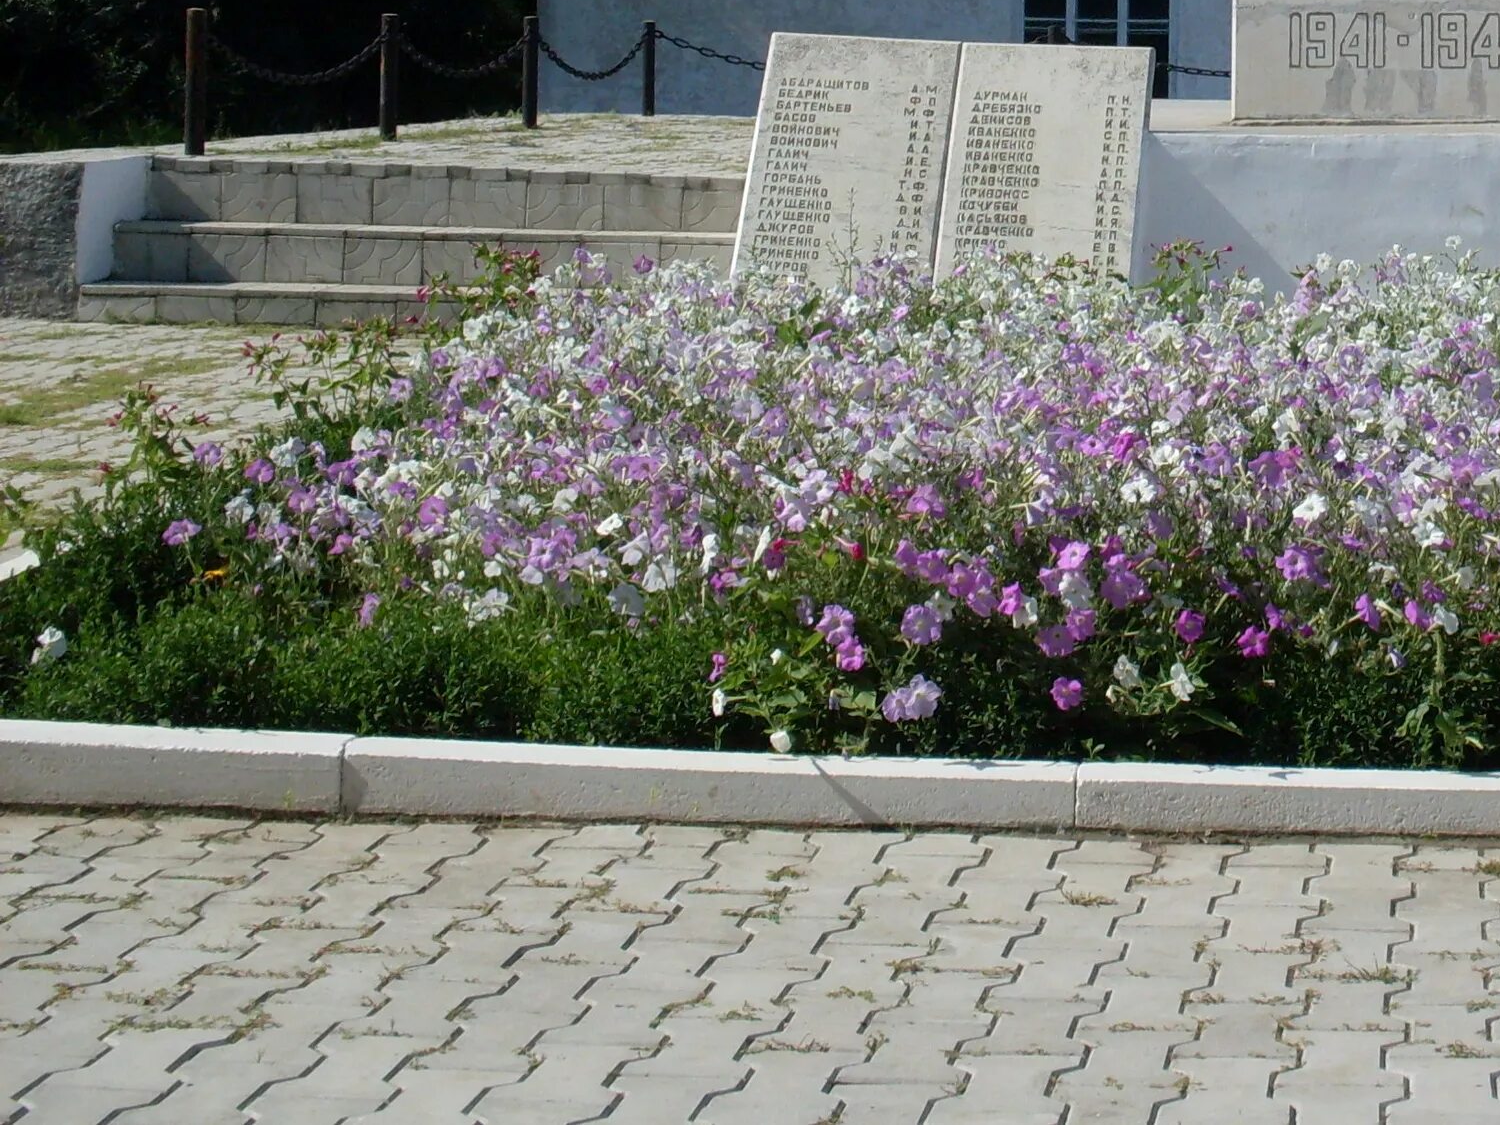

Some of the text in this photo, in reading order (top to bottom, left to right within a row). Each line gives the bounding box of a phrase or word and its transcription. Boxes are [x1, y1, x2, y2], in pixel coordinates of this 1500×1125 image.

[974, 91, 1028, 101] ДУРМАН
[776, 99, 852, 113] БАРТЕНЬЕВ
[774, 112, 816, 123] БАСОВ
[970, 116, 1031, 125] ДЕНИСОВ
[968, 128, 1036, 137] ИВАНЕНКО
[967, 140, 1034, 149] ИВАНЕНКО
[768, 147, 810, 159] ГАЛИЧ
[965, 152, 1033, 162] ИВАНЕНКО
[766, 160, 808, 172] ГАЛИЧ
[963, 164, 1040, 175] КРАВЧЕНКО
[764, 172, 822, 185] ГОРБАНЬ
[962, 176, 1039, 188] КРАВЧЕНКО
[761, 185, 829, 197] ГРИНЕНКО
[961, 189, 1030, 199] КРИВОНОС
[756, 221, 815, 234] ДЖУРОВ
[956, 226, 1034, 238] КРАВЧЕНКО
[753, 234, 821, 247] ГРИНЕНКО
